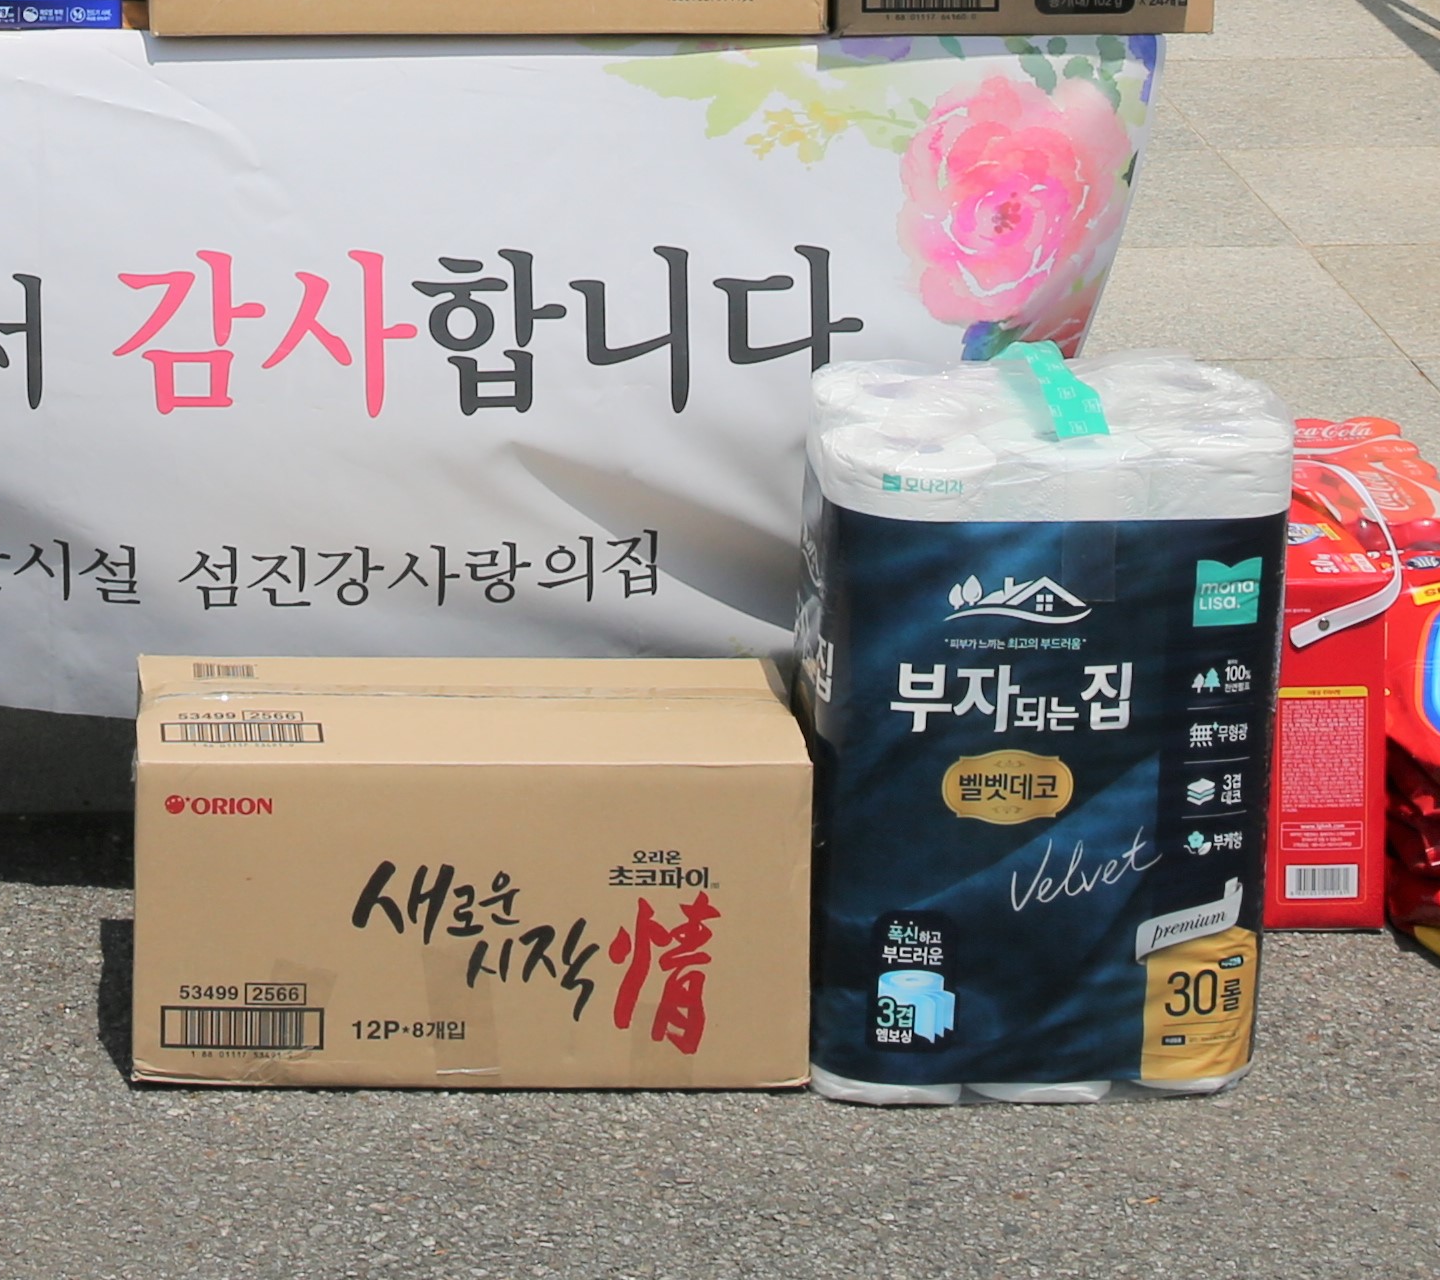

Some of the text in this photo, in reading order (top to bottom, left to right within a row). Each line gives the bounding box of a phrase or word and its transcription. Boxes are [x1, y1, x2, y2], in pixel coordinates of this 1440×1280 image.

[111, 245, 864, 418] 감사합니다
[180, 530, 660, 610] 섬진강사랑의집
[1200, 580, 1254, 594] mona
[959, 773, 1058, 801] 벨벳데코
[191, 796, 273, 815] ORION
[632, 849, 681, 865] 오리온
[1009, 826, 1163, 913] Velvet
[608, 866, 709, 889] 초코파이
[352, 859, 520, 944] 새로운
[1151, 911, 1226, 948] premium
[467, 918, 599, 1022] 시작
[882, 945, 943, 965] 부드러운
[608, 891, 721, 1056] 情
[179, 984, 300, 1002] 53499 2566
